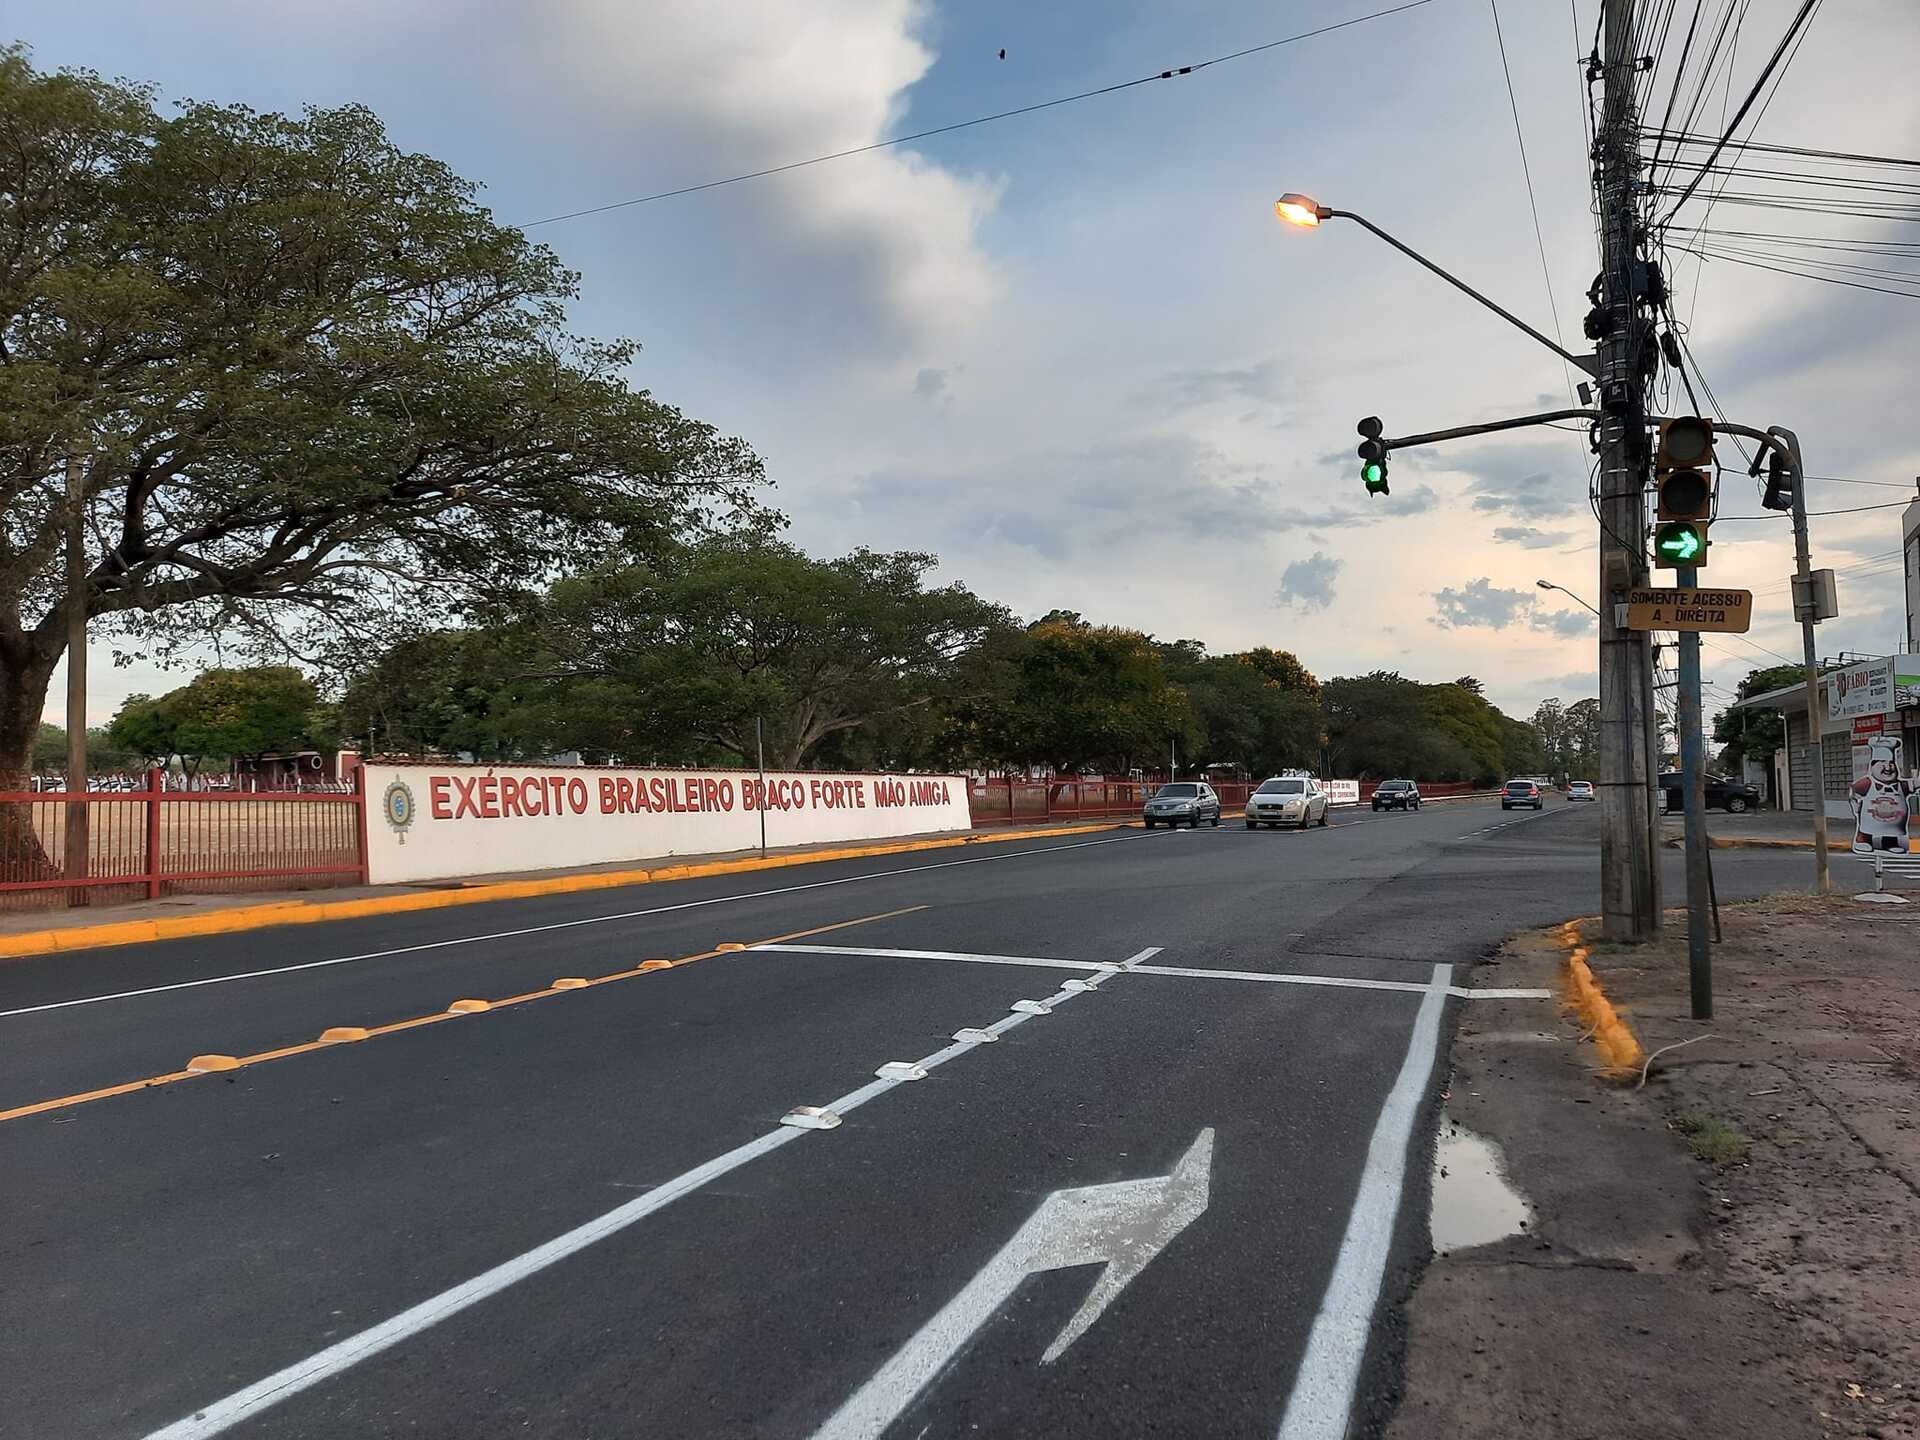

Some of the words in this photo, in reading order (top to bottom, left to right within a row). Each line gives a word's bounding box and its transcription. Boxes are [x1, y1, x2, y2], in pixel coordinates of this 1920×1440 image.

[1631, 592, 1688, 606] SOMENTE
[1691, 594, 1743, 607] ACESSO
[1675, 609, 1726, 624] DIREITA
[429, 768, 588, 819] EXÉRCITO
[599, 777, 734, 814] BRASILEIRO
[741, 779, 806, 812] BRAÇO
[811, 779, 866, 809] FORTE
[874, 777, 906, 808] MÃO
[909, 780, 951, 806] AMIGA
